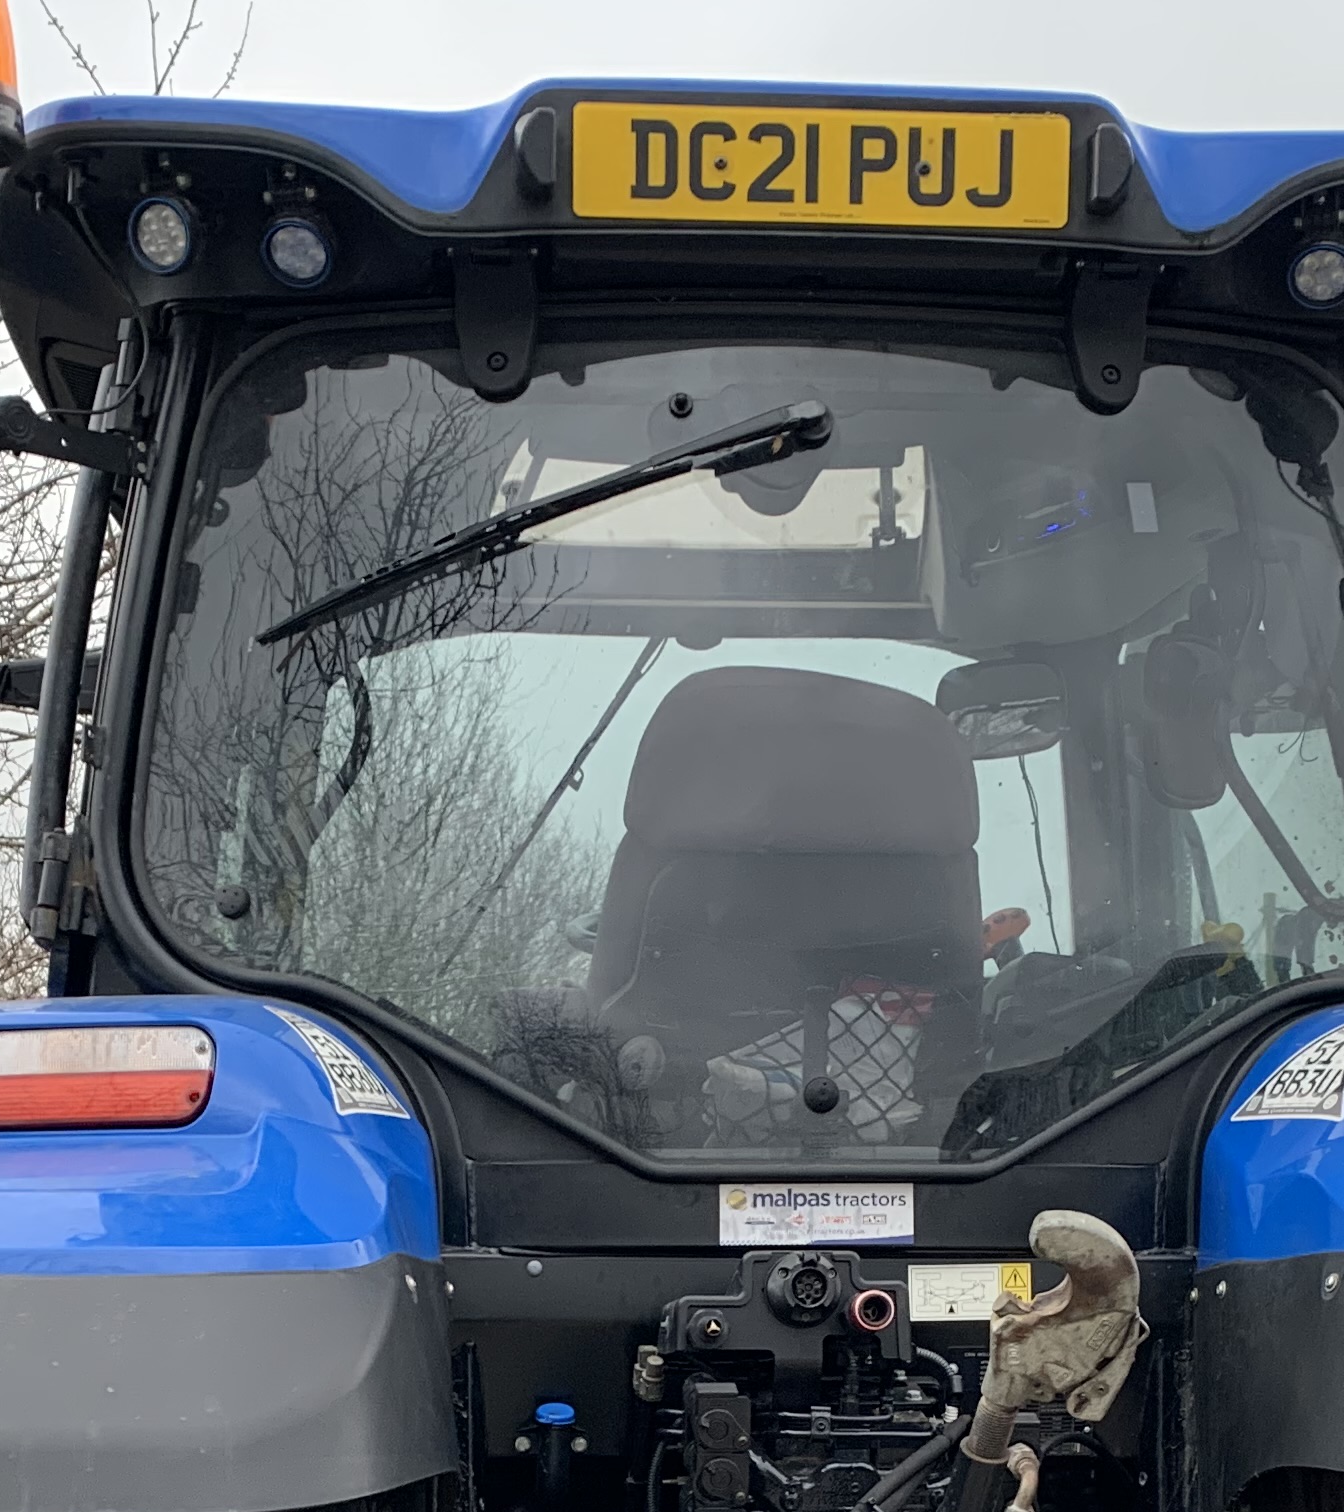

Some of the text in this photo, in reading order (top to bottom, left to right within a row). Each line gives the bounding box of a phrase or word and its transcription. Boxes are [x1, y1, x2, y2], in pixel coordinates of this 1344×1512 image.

[631, 118, 1014, 209] DC21 PUJ
[1267, 1068, 1343, 1098] BB3U
[752, 1188, 906, 1211] malpas tractors
